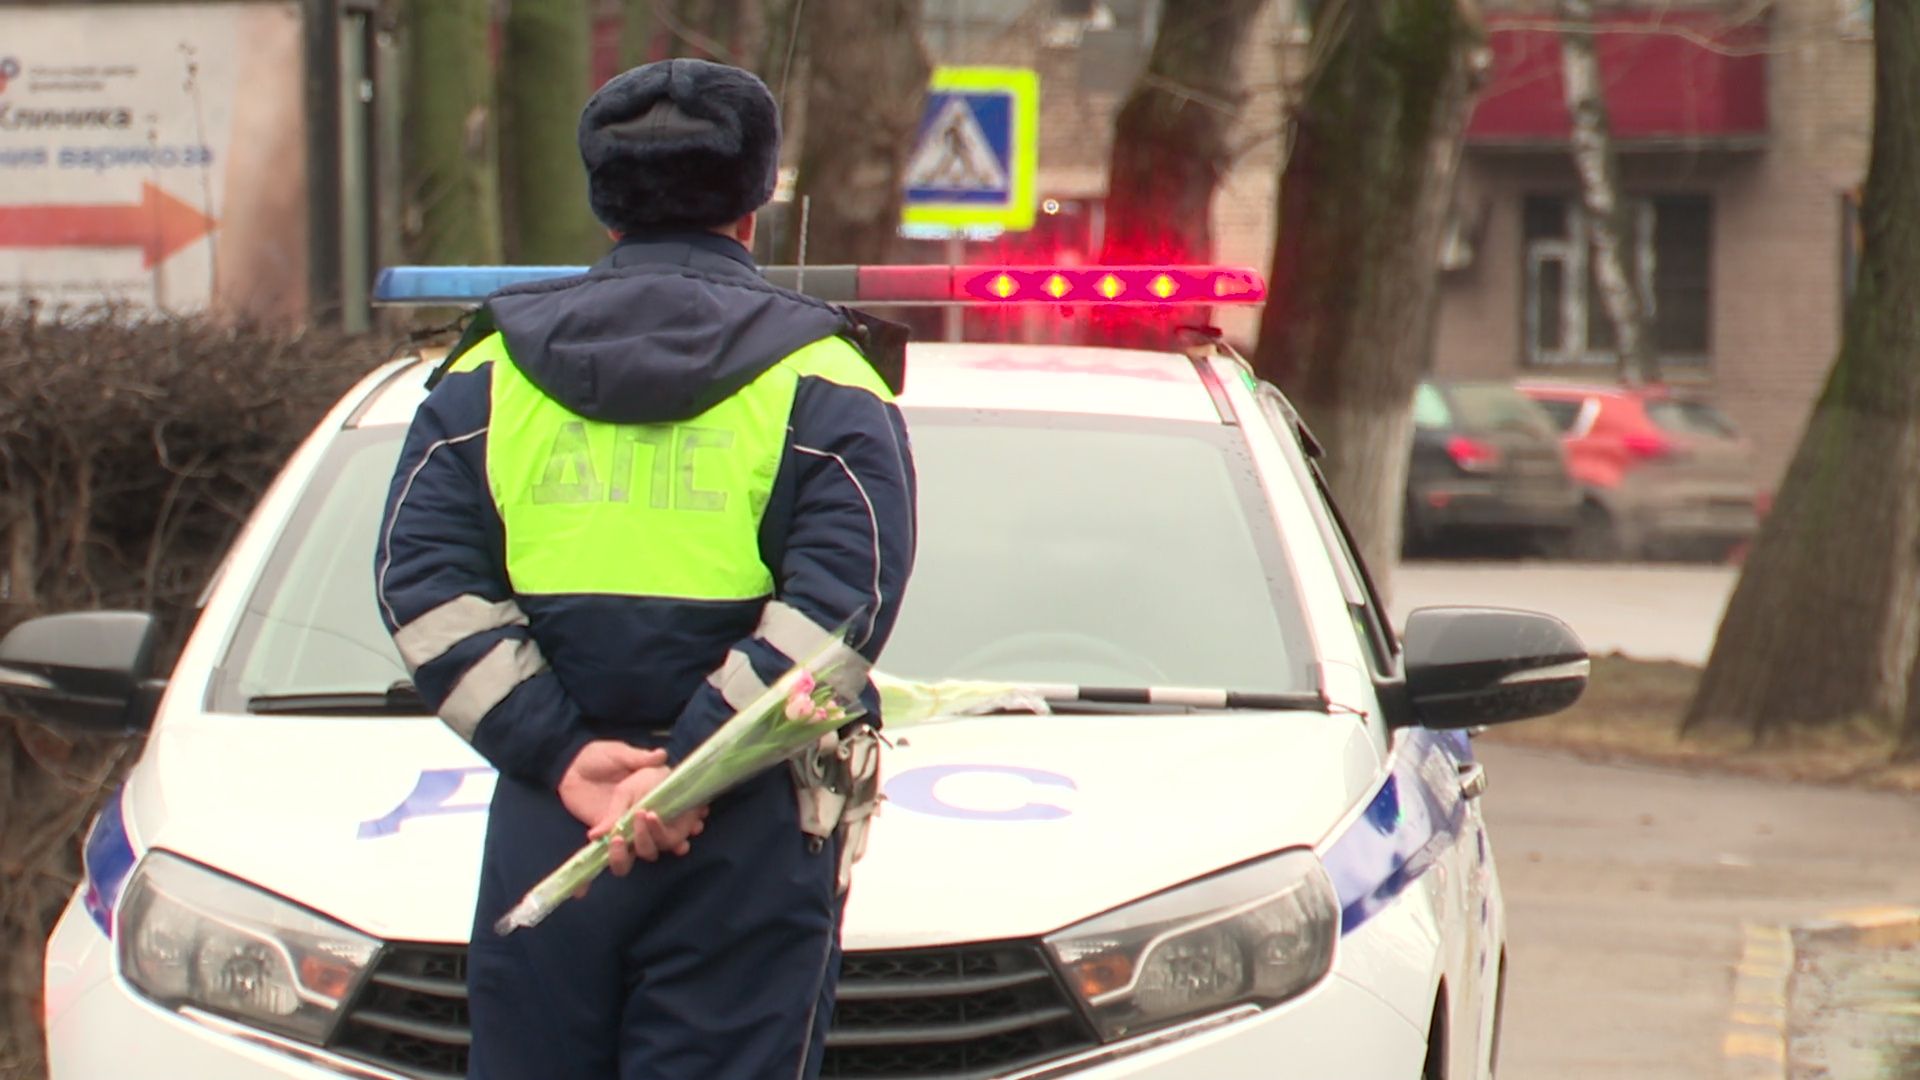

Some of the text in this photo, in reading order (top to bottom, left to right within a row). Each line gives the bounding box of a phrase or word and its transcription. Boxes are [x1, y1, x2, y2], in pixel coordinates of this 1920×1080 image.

[58, 146, 213, 173] варикоза
[532, 421, 735, 512] ДПС
[357, 764, 1078, 840] ДС
